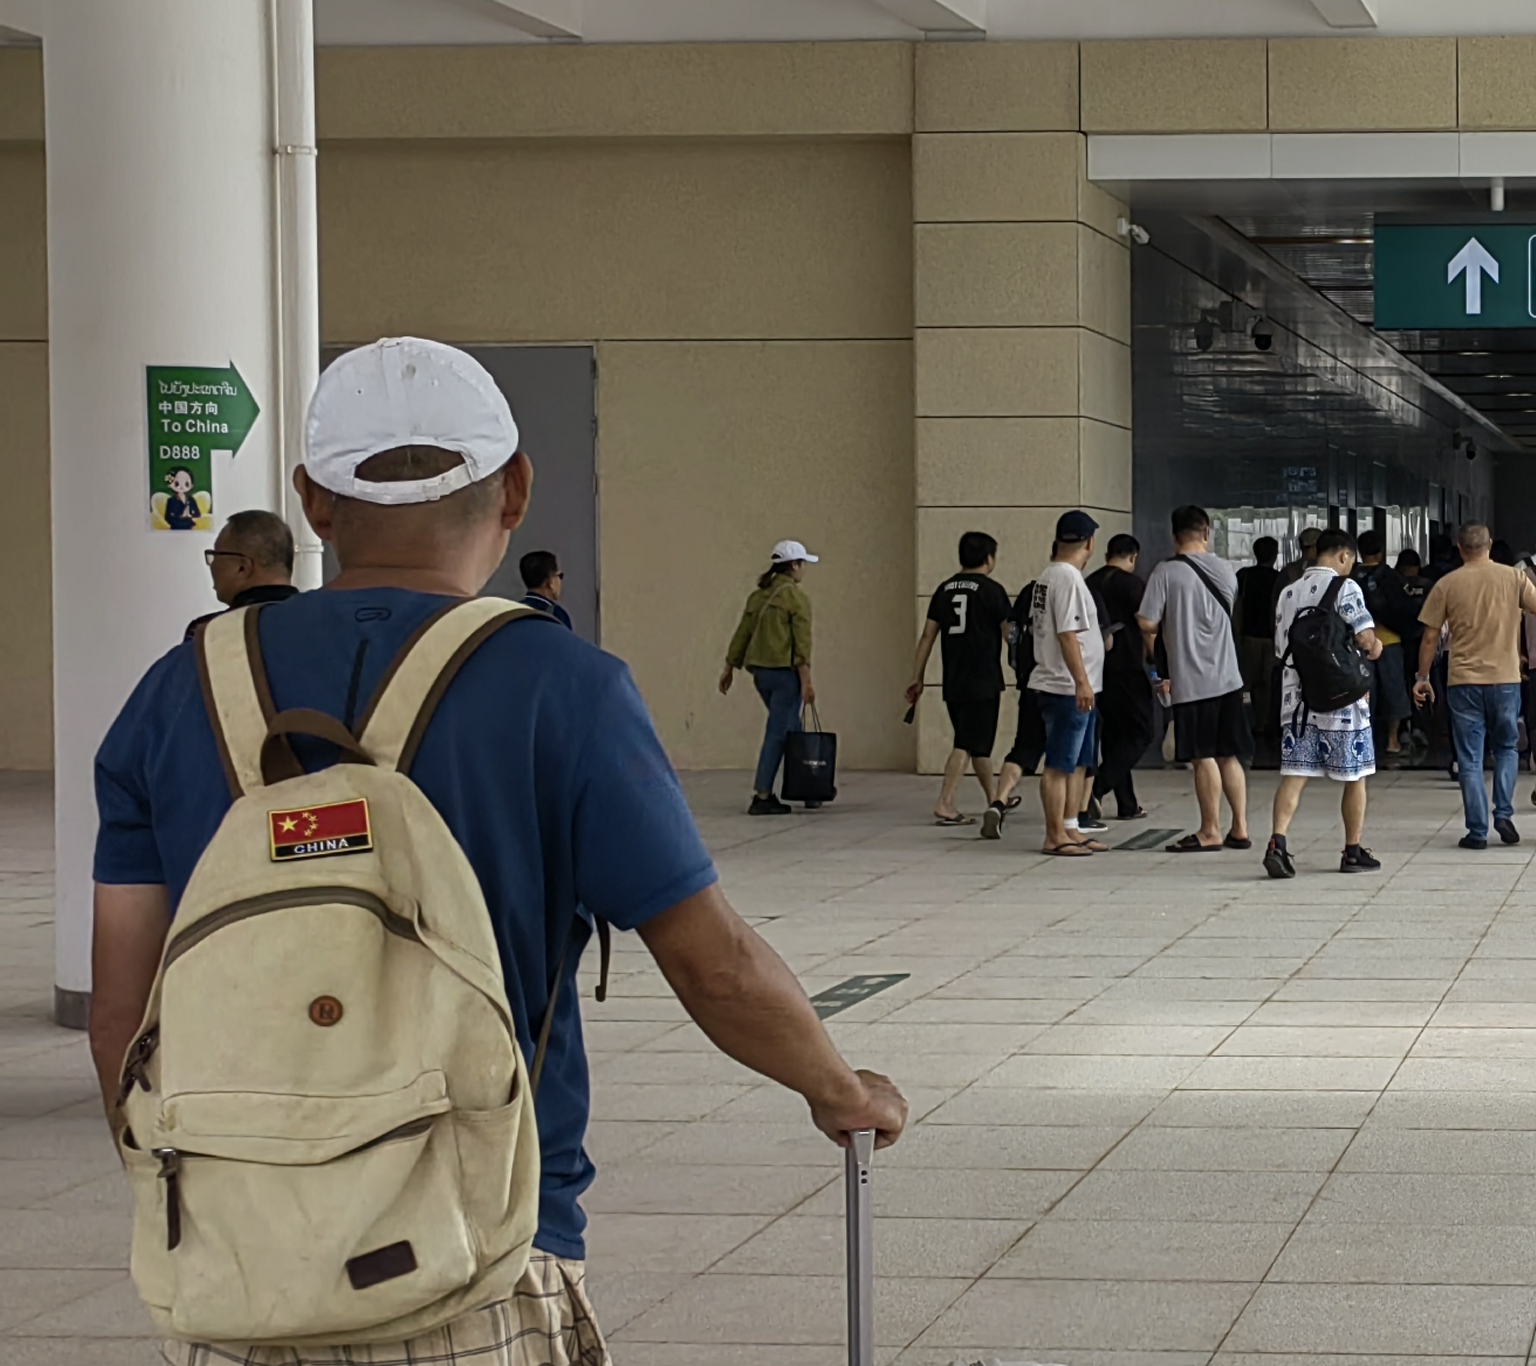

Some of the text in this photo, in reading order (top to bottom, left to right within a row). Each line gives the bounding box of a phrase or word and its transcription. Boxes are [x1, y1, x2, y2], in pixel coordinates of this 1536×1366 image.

[158, 400, 219, 415] 中国方向
[161, 418, 229, 434] To China
[159, 445, 201, 460] D888
[948, 593, 968, 635] 3
[293, 837, 349, 854] CHINA
